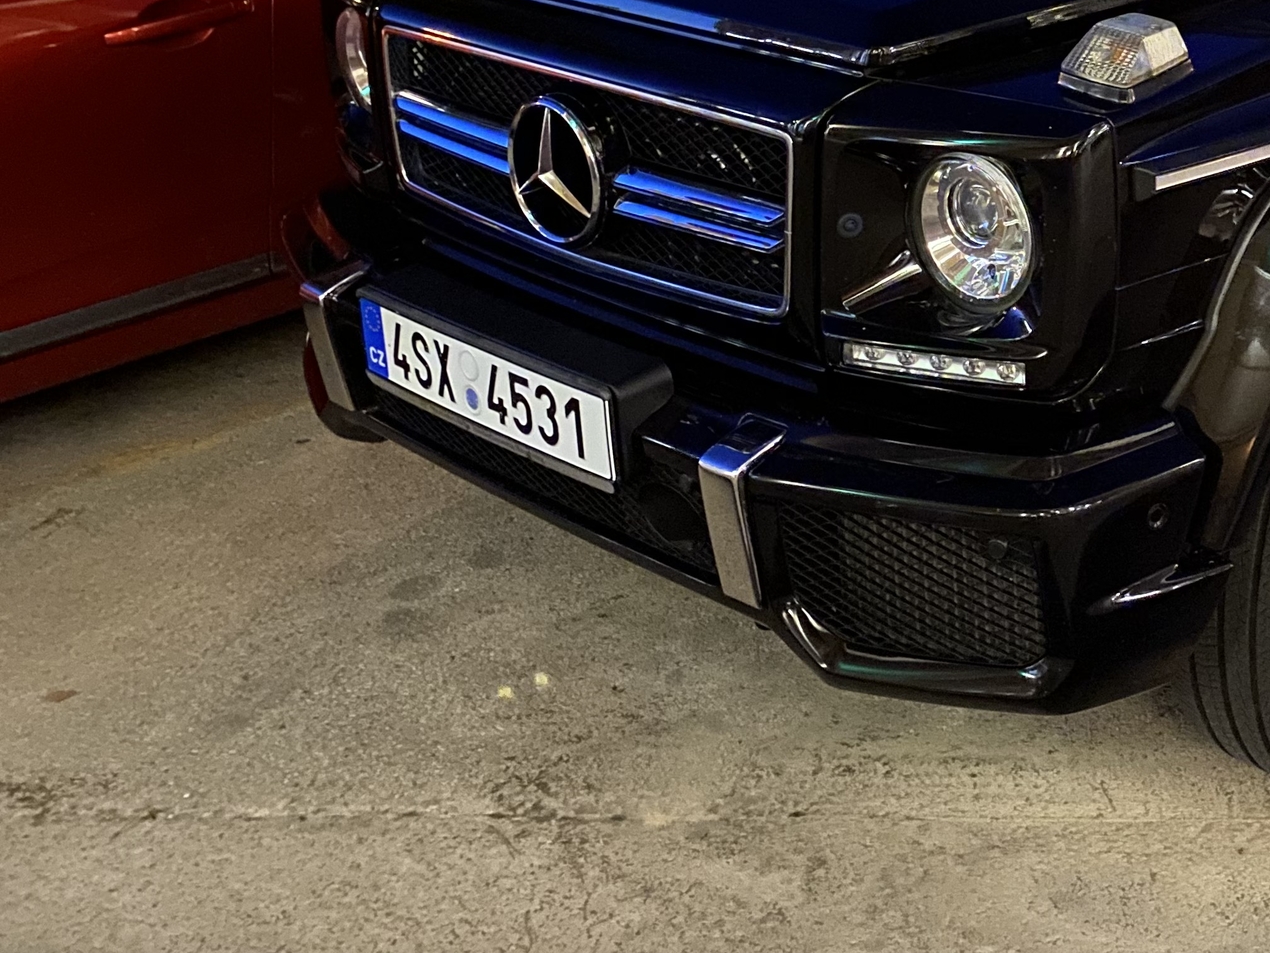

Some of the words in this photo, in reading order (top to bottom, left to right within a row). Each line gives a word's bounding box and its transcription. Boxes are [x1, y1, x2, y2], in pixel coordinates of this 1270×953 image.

[369, 346, 386, 368] CZ
[393, 322, 457, 404] 4SX
[487, 363, 586, 461] 4531
